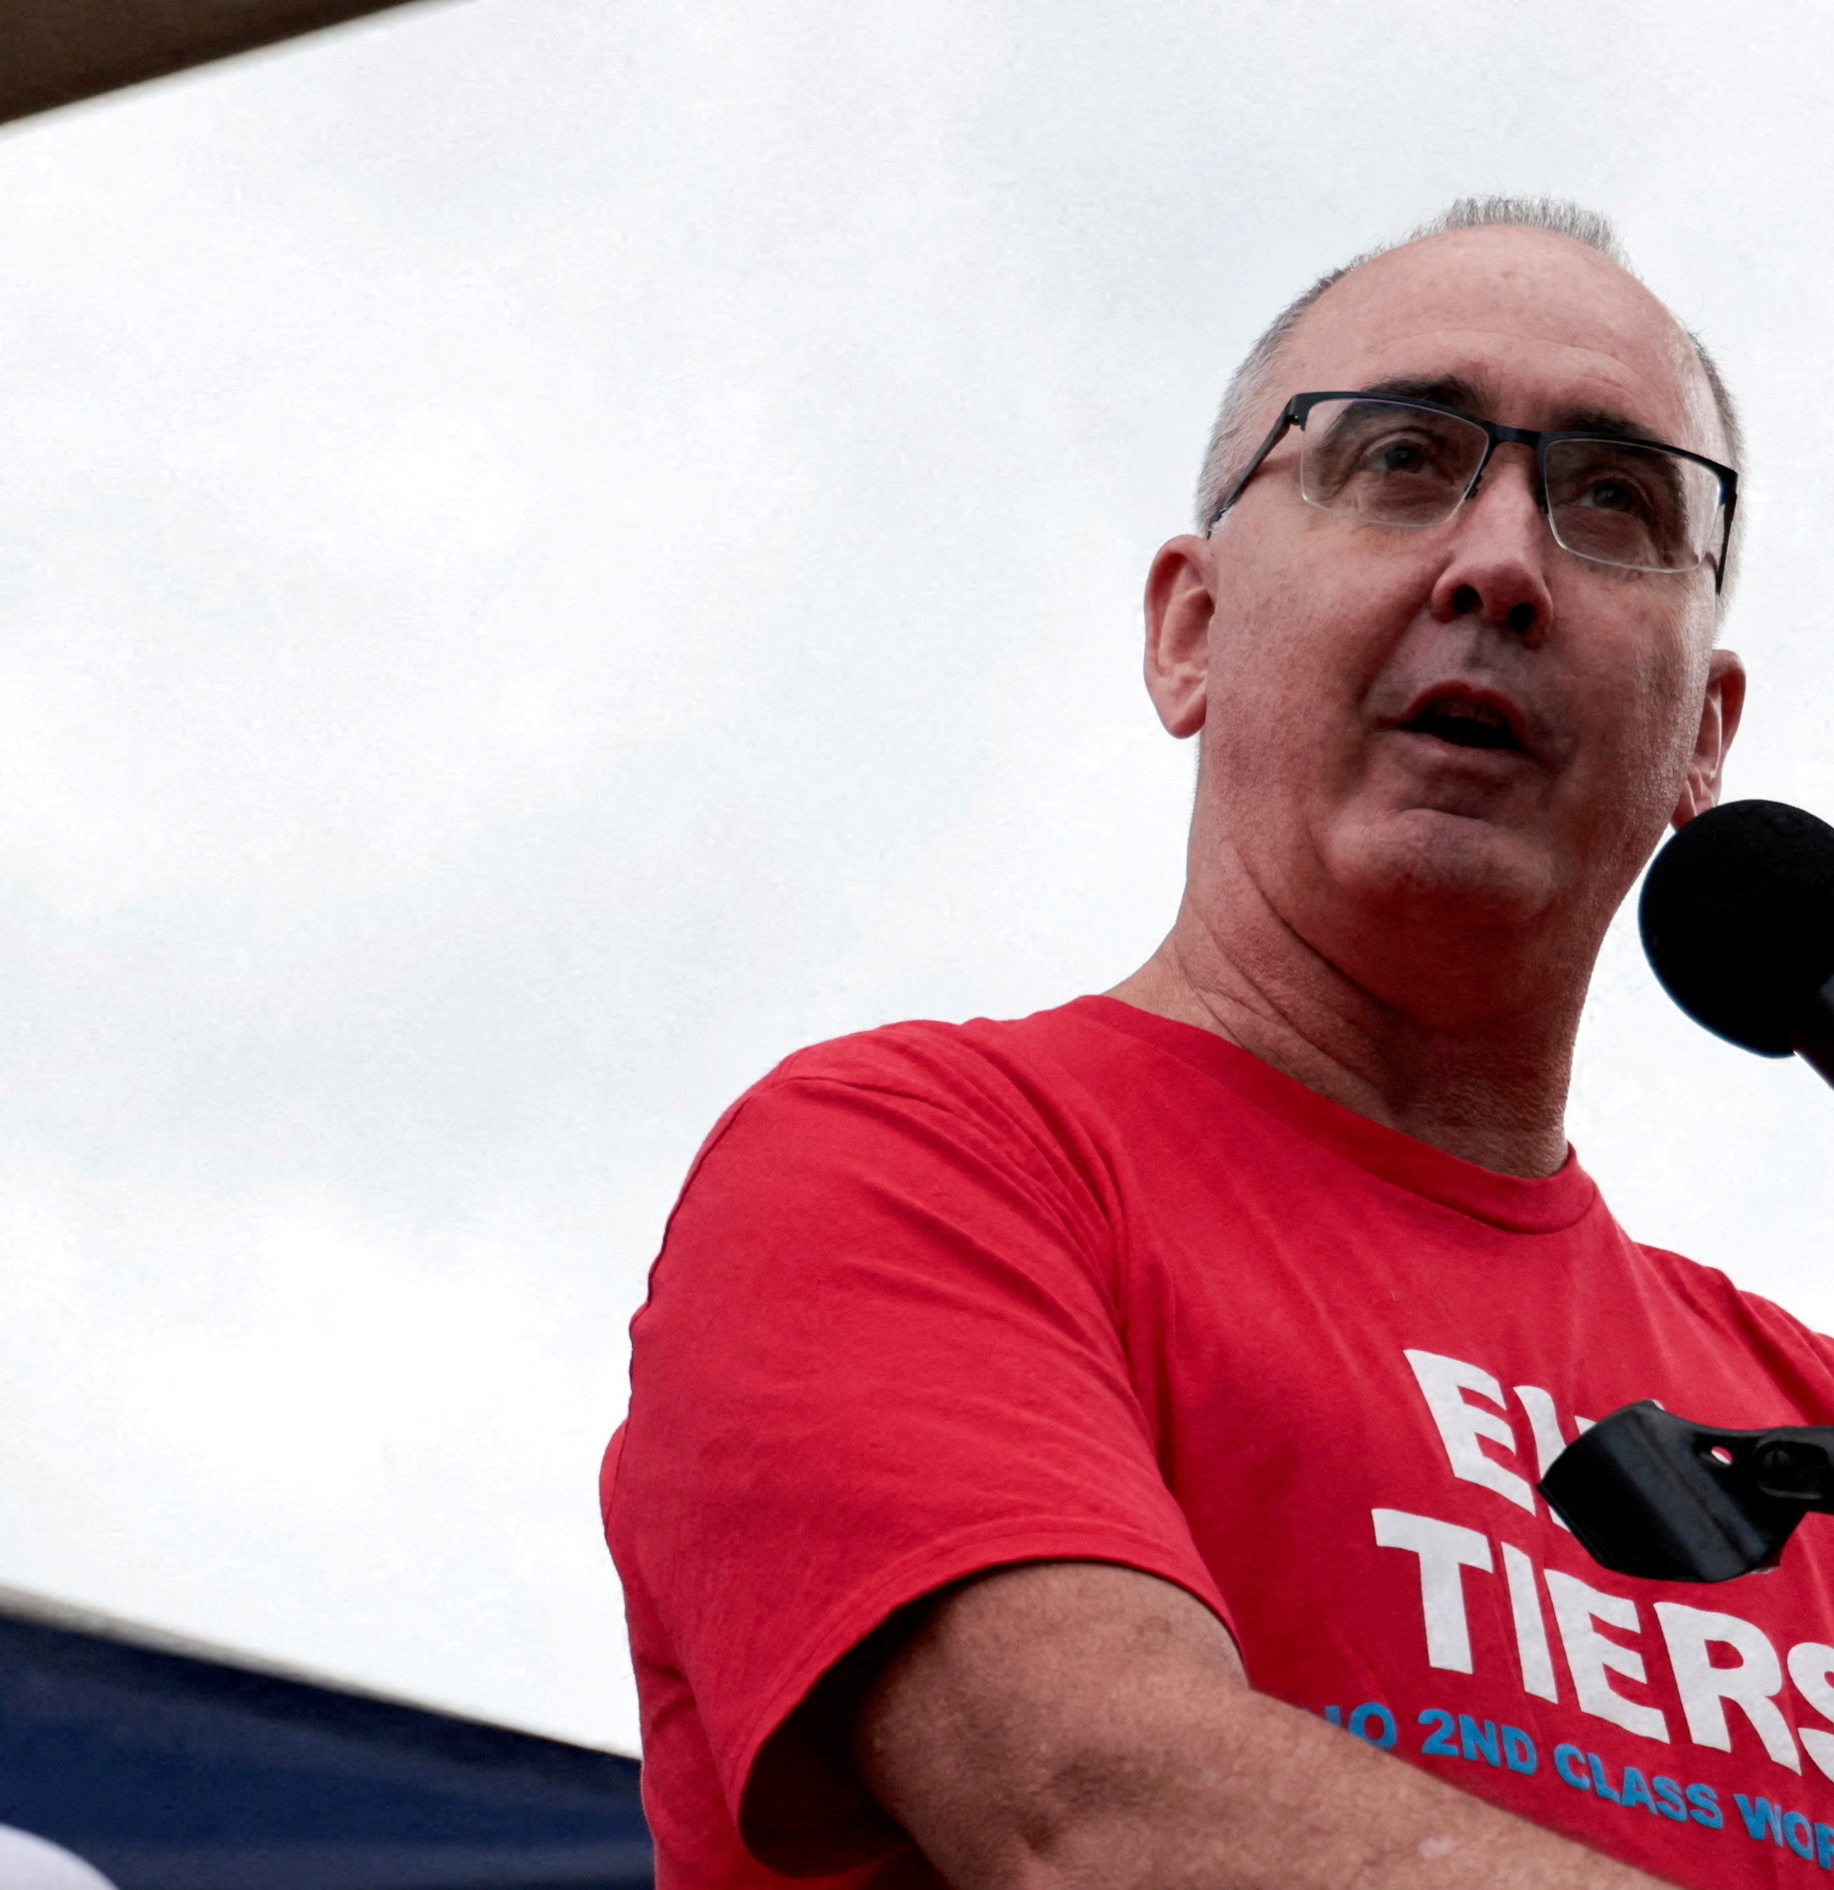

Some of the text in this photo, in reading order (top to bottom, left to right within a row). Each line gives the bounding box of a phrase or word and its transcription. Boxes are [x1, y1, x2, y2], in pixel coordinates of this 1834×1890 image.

[1301, 1701, 1398, 1750] O
[1416, 1708, 1538, 1776] 2ND
[1553, 1743, 1725, 1830] CLASS
